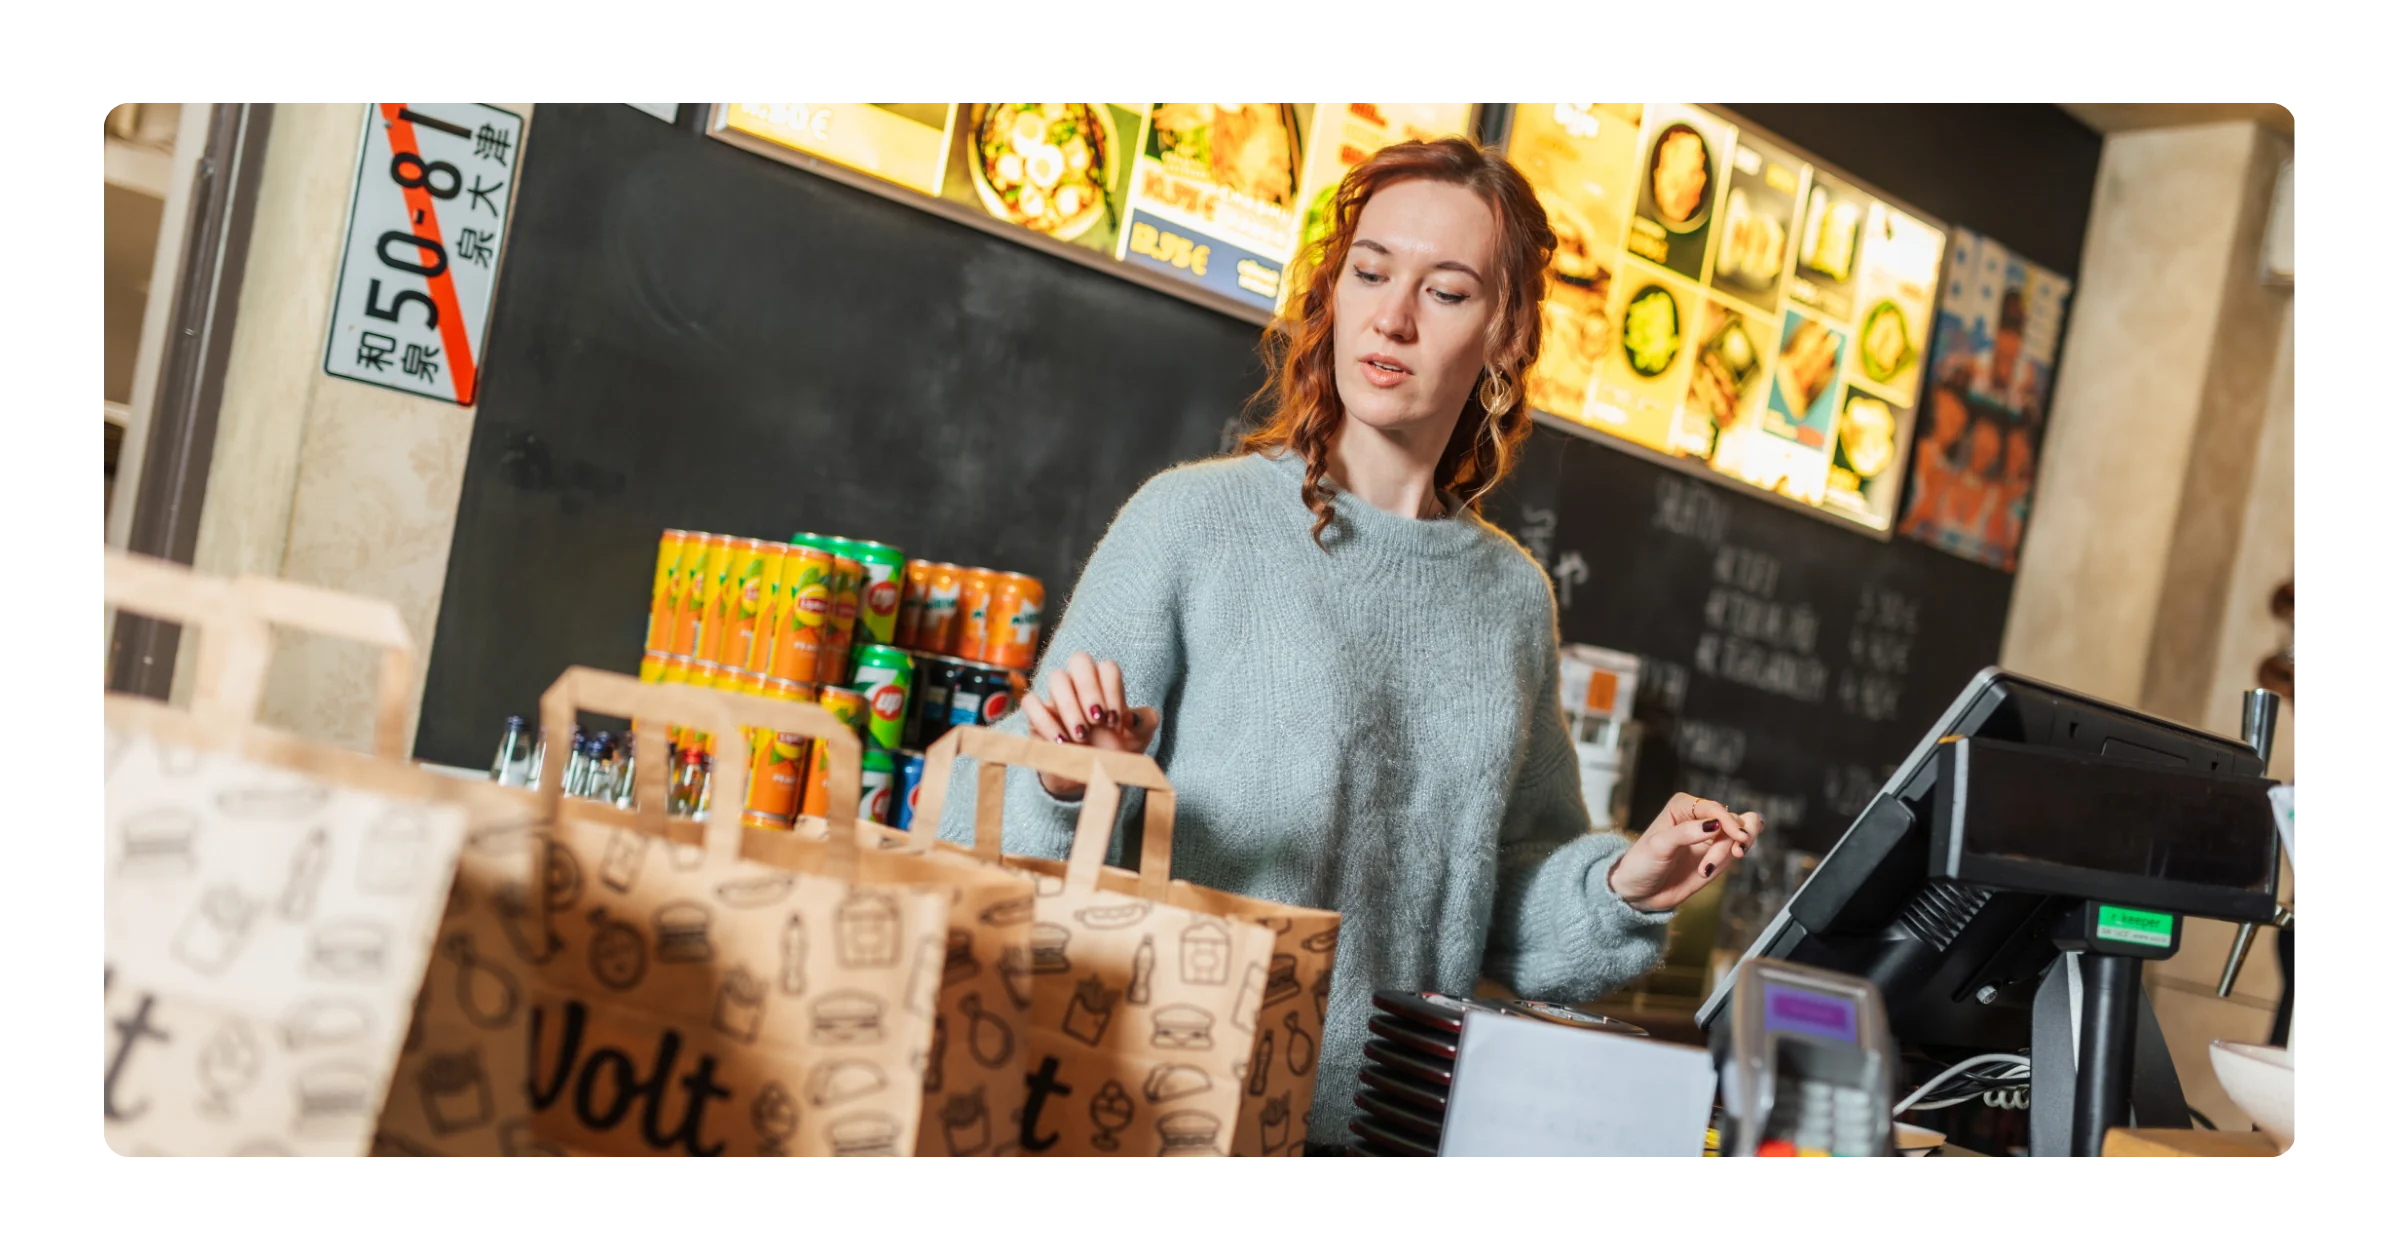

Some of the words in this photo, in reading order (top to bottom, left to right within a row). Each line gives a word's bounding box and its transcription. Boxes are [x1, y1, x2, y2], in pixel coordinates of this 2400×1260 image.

[364, 107, 473, 332] 50-81
[455, 122, 512, 270] 泉大津
[356, 330, 441, 384] 和泉
